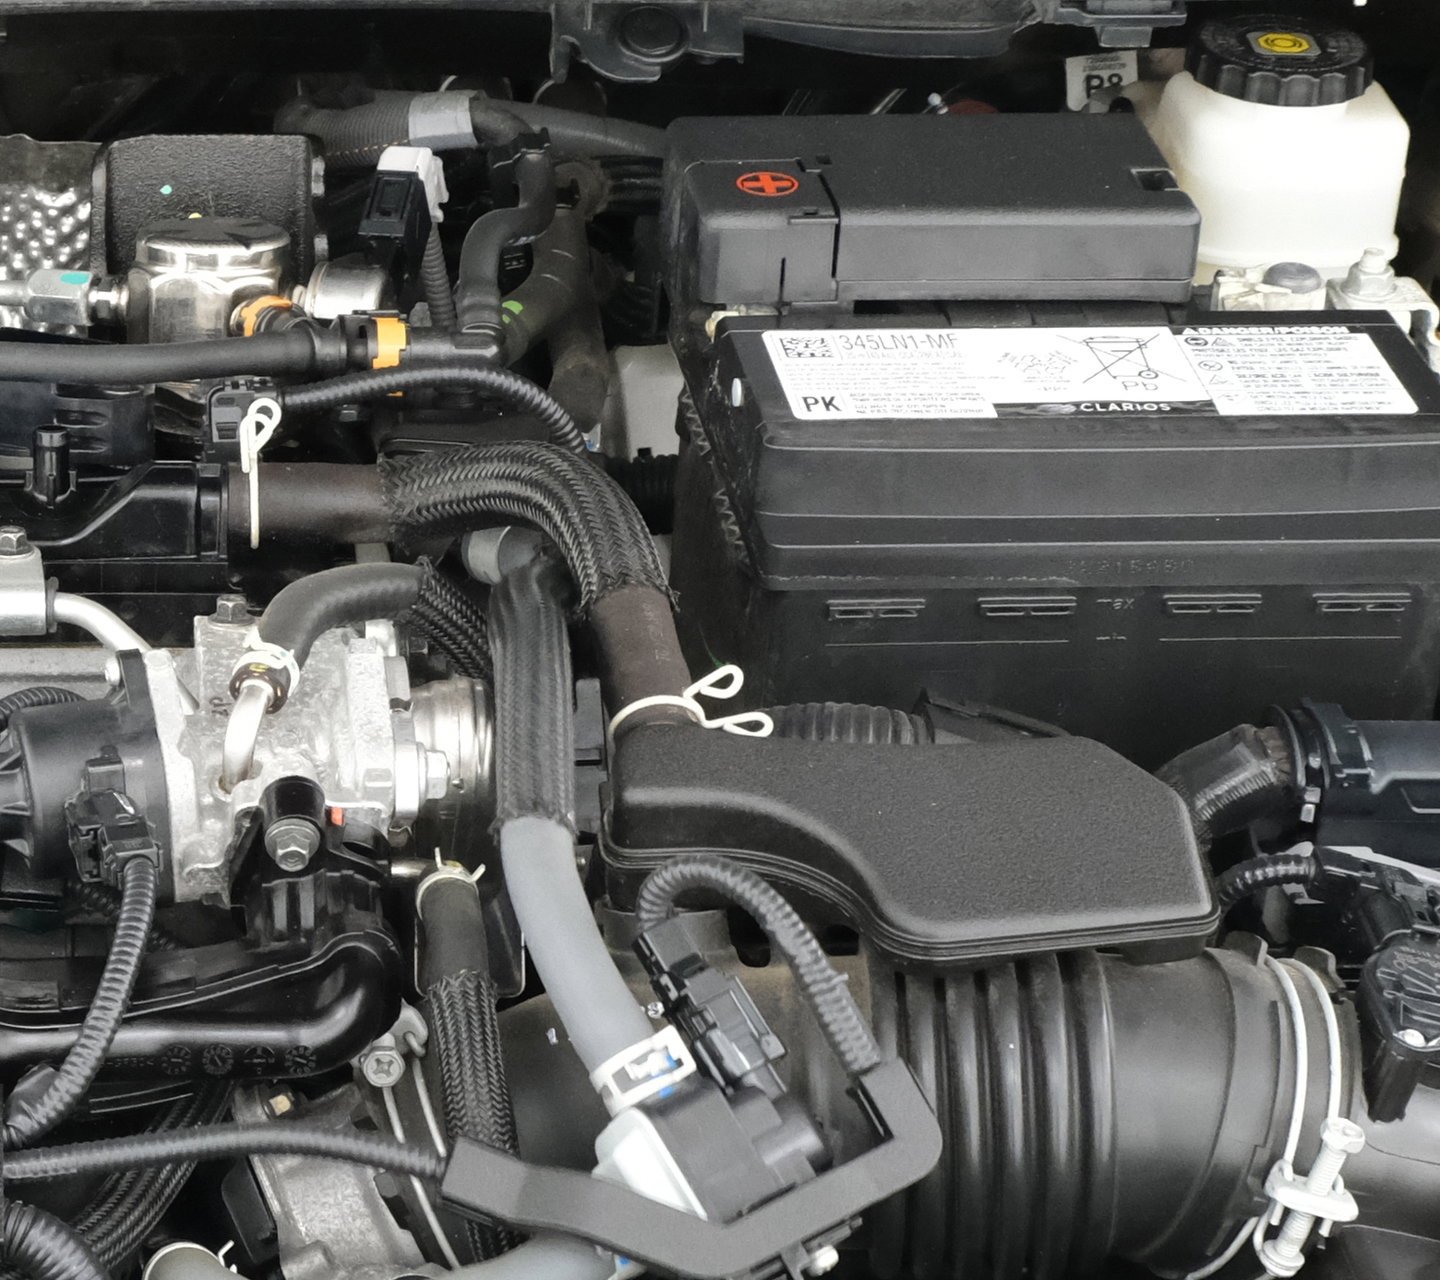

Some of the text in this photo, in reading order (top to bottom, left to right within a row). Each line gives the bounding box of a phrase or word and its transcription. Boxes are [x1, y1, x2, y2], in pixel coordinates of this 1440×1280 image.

[838, 332, 960, 351] 345LN1-MF
[1121, 380, 1159, 391] Pb
[801, 395, 843, 413] PK
[1079, 402, 1172, 412] CLARIOS
